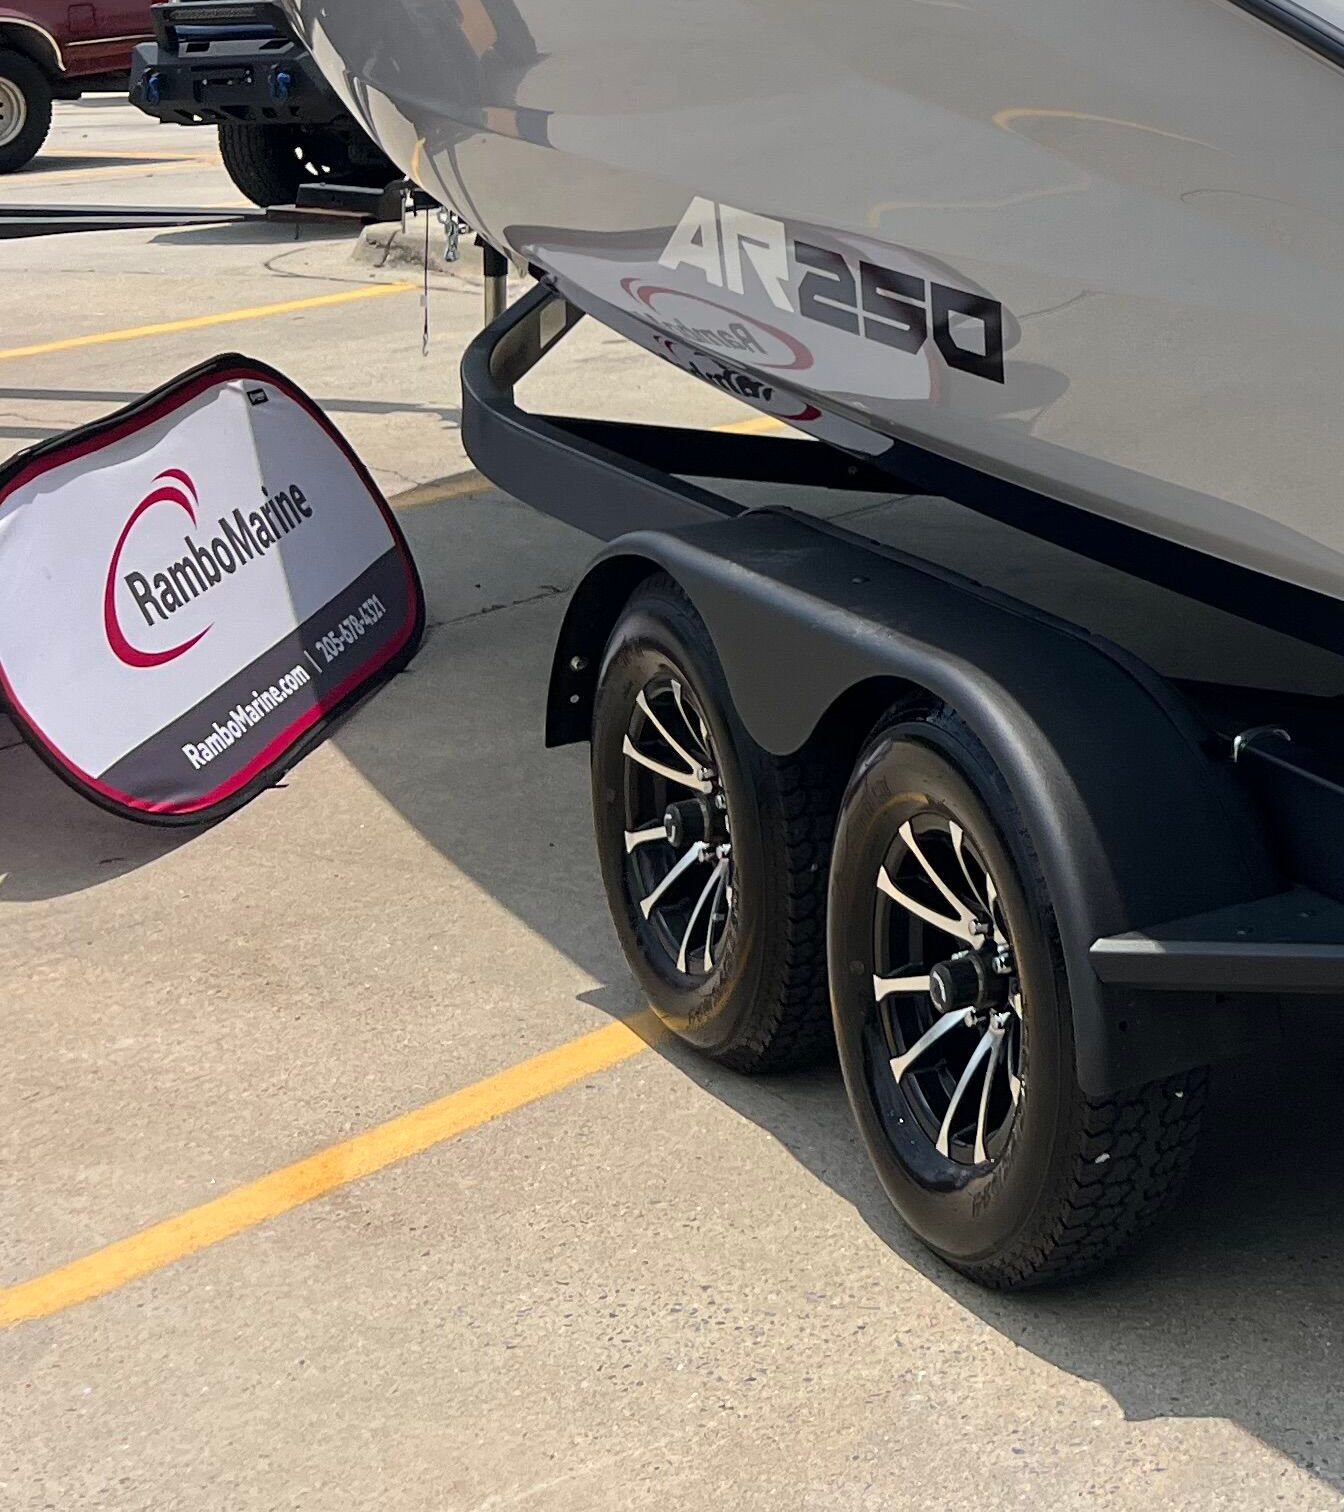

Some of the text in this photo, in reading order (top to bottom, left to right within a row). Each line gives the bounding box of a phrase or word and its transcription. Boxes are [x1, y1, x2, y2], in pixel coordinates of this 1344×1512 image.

[657, 195, 1005, 385] AR250
[124, 484, 314, 626] RamboMarine
[181, 593, 388, 770] RamboMarine.com 205-678-4321
